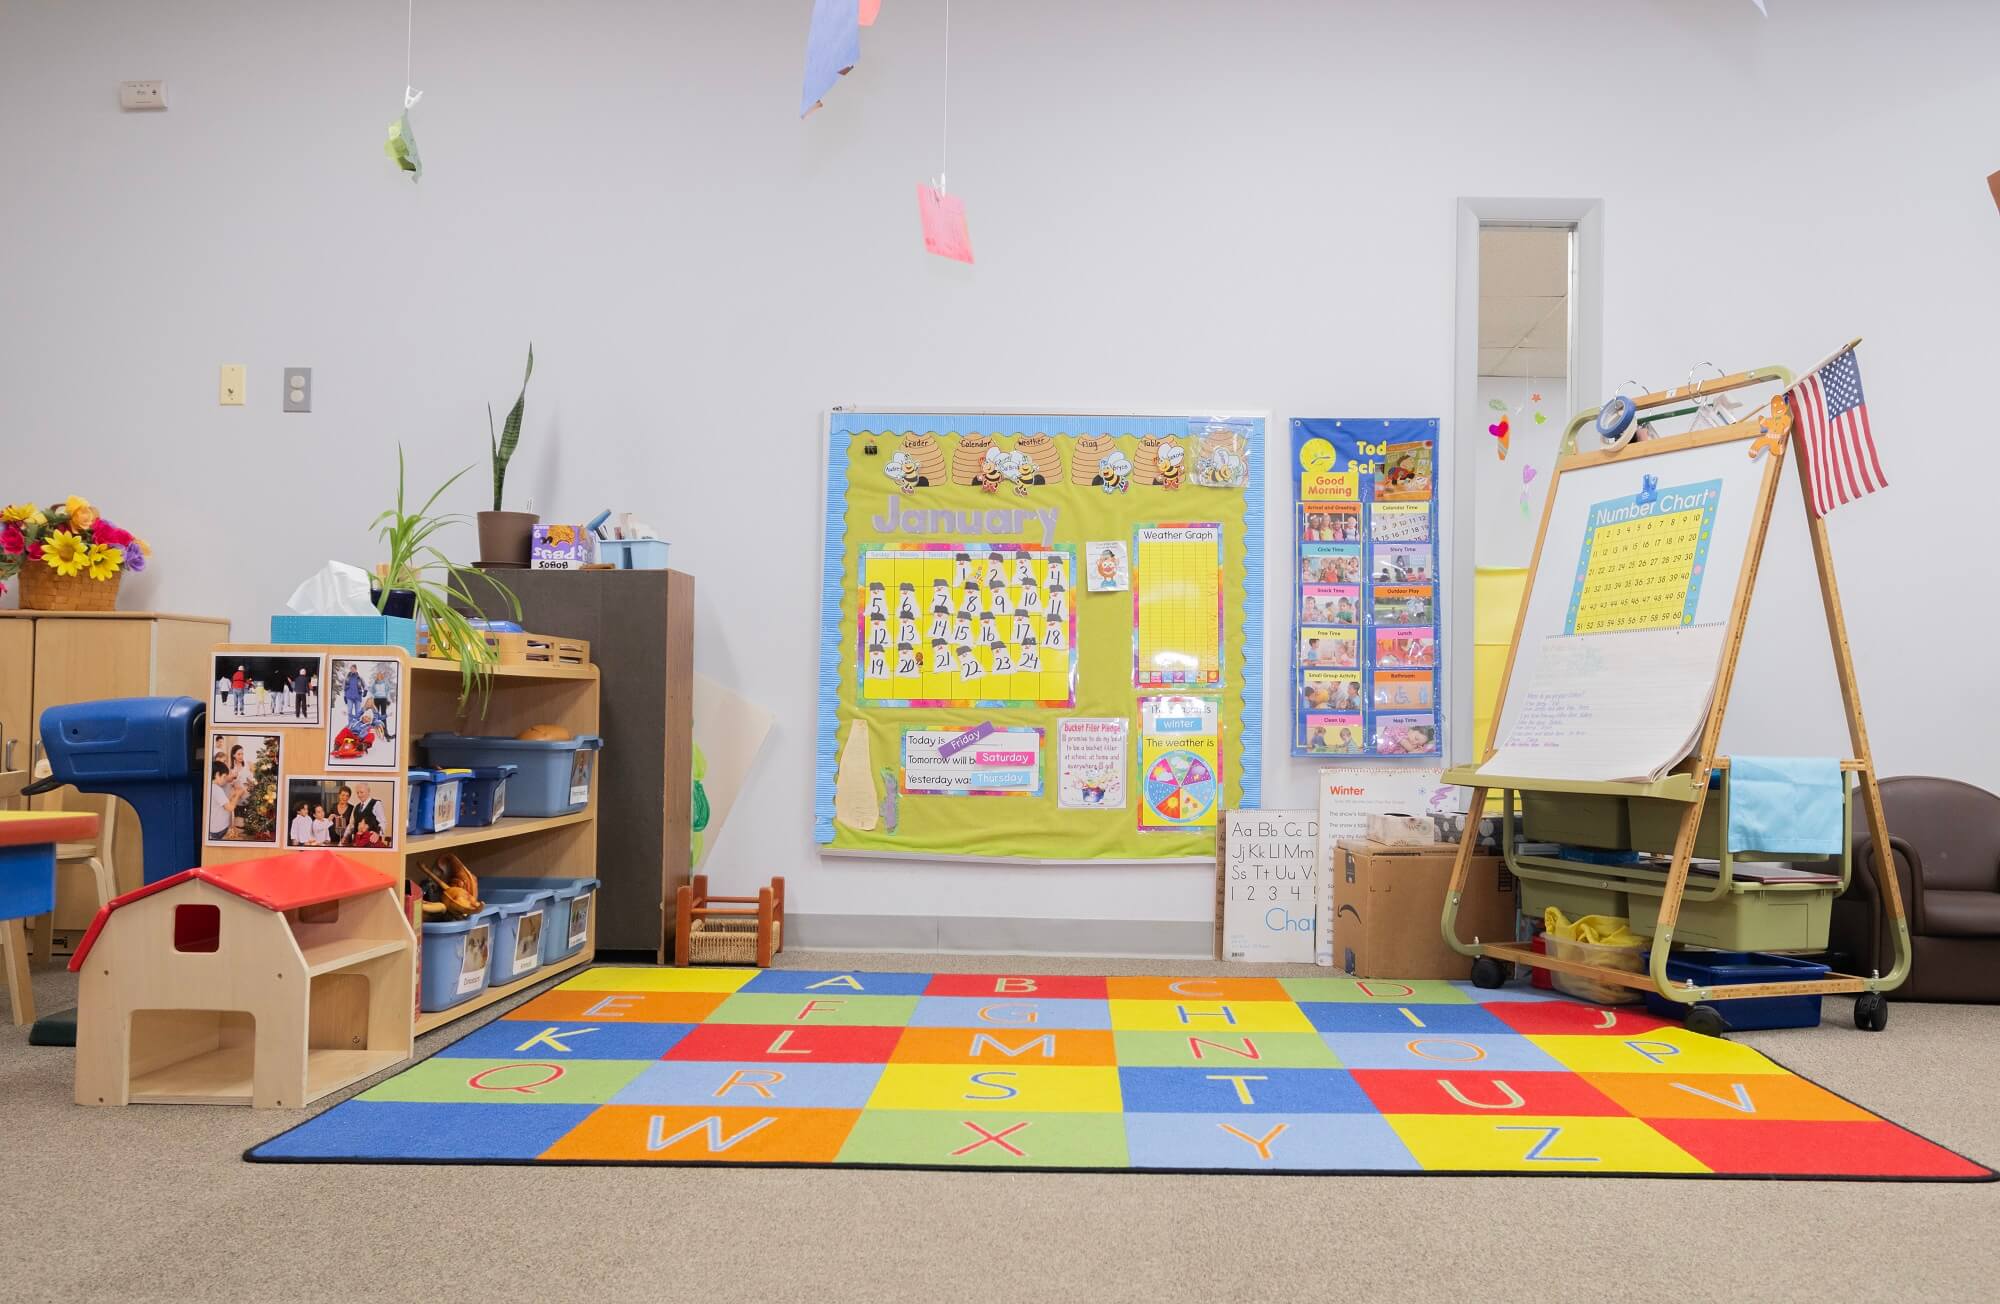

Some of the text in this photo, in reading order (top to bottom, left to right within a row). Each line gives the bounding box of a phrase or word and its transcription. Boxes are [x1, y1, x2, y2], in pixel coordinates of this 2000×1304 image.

[905, 440, 928, 448] Leader
[1018, 438, 1045, 446] Weather
[1082, 441, 1097, 450] Flag
[1308, 486, 1352, 496] Morning
[1316, 477, 1344, 485] Good
[1596, 489, 1708, 524] Number Chart
[872, 495, 1060, 547] January
[1143, 531, 1213, 542] Weather Graph
[990, 569, 998, 581] 2
[1051, 571, 1060, 585] 4
[872, 592, 1061, 615] 5 6 7 8 9 10 11
[874, 621, 1060, 645] 12 13 14 15 16 17 18
[871, 653, 1038, 677] 19 20 21 22 23 24
[909, 736, 935, 747] Today
[951, 729, 980, 750] Friday
[1147, 739, 1214, 747] The weather is
[909, 756, 950, 764] Tomorrow
[953, 756, 967, 764] will
[982, 753, 1029, 763] Saturday
[908, 775, 952, 786] Yesterday
[978, 774, 1023, 783] Thursday
[1329, 786, 1365, 796] Winter
[1232, 822, 1252, 837] Aa
[1258, 822, 1277, 837] Bb
[1284, 822, 1302, 837] Cc
[1232, 844, 1314, 863] Jj Kk Ll Mm
[1232, 865, 1247, 880] Ss
[1253, 865, 1270, 880] Tt
[1276, 865, 1295, 880] Uu
[1247, 886, 1255, 901] 2
[1269, 886, 1277, 901] 3
[1291, 886, 1300, 901] 4
[805, 975, 864, 991] A
[993, 977, 1037, 994] B
[1169, 980, 1224, 998] C
[1354, 981, 1415, 998] D
[581, 996, 647, 1018] E
[796, 1000, 845, 1020] F
[977, 1002, 1038, 1024] G
[1176, 1005, 1237, 1026] H
[514, 1026, 599, 1053] K
[765, 1030, 813, 1055] L
[969, 1034, 1056, 1057] M
[1187, 1036, 1262, 1061] N
[1407, 1039, 1489, 1063] O
[1625, 1041, 1682, 1065] P
[467, 1062, 567, 1095] Q
[713, 1069, 786, 1098] R
[965, 1071, 1021, 1101] S
[1207, 1075, 1268, 1106] T
[1436, 1079, 1527, 1109] U
[1669, 1081, 1756, 1114] V
[646, 1115, 779, 1154] W
[950, 1120, 1033, 1157] X
[1217, 1123, 1290, 1161] Y
[1495, 1125, 1601, 1162] Z
